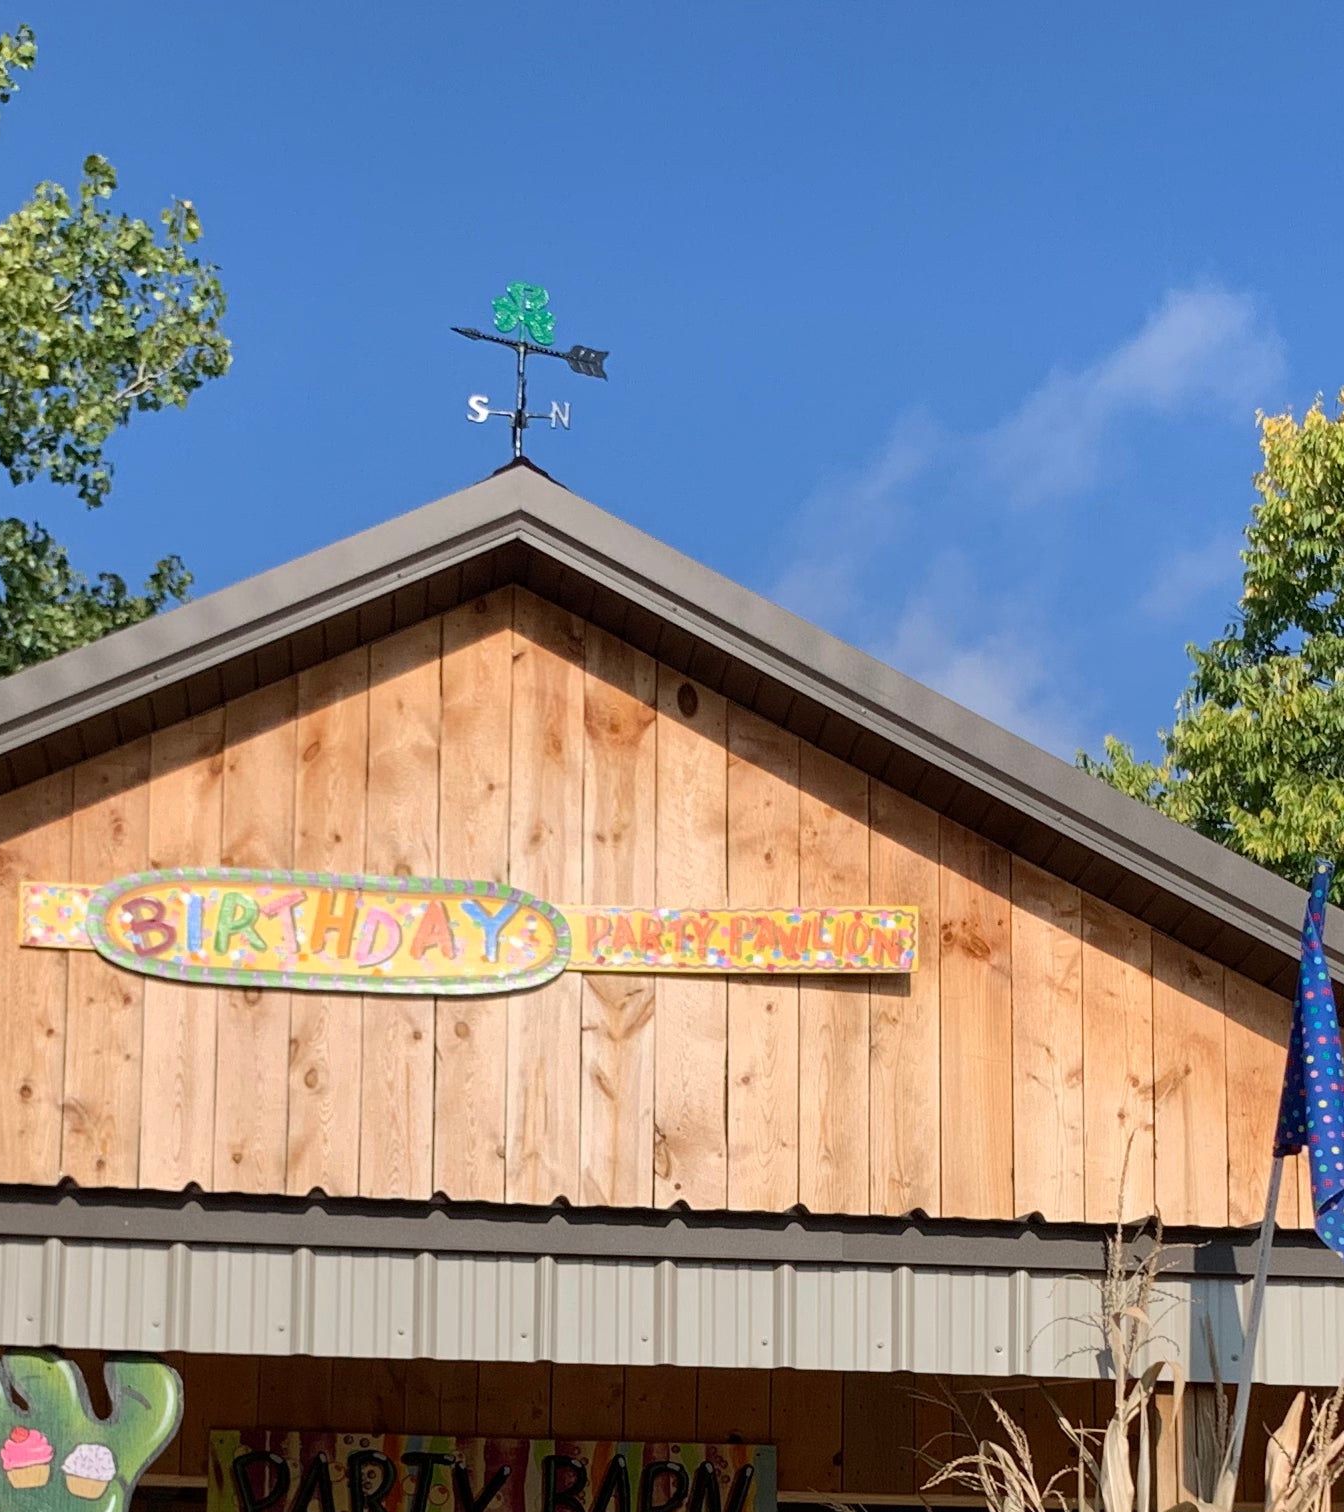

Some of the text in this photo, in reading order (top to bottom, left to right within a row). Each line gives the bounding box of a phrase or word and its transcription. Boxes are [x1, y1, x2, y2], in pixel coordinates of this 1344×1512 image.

[467, 395, 489, 423] S
[550, 401, 570, 430] N
[122, 887, 520, 968] BIRTHDAY
[585, 914, 906, 965] PARTY PAVILION
